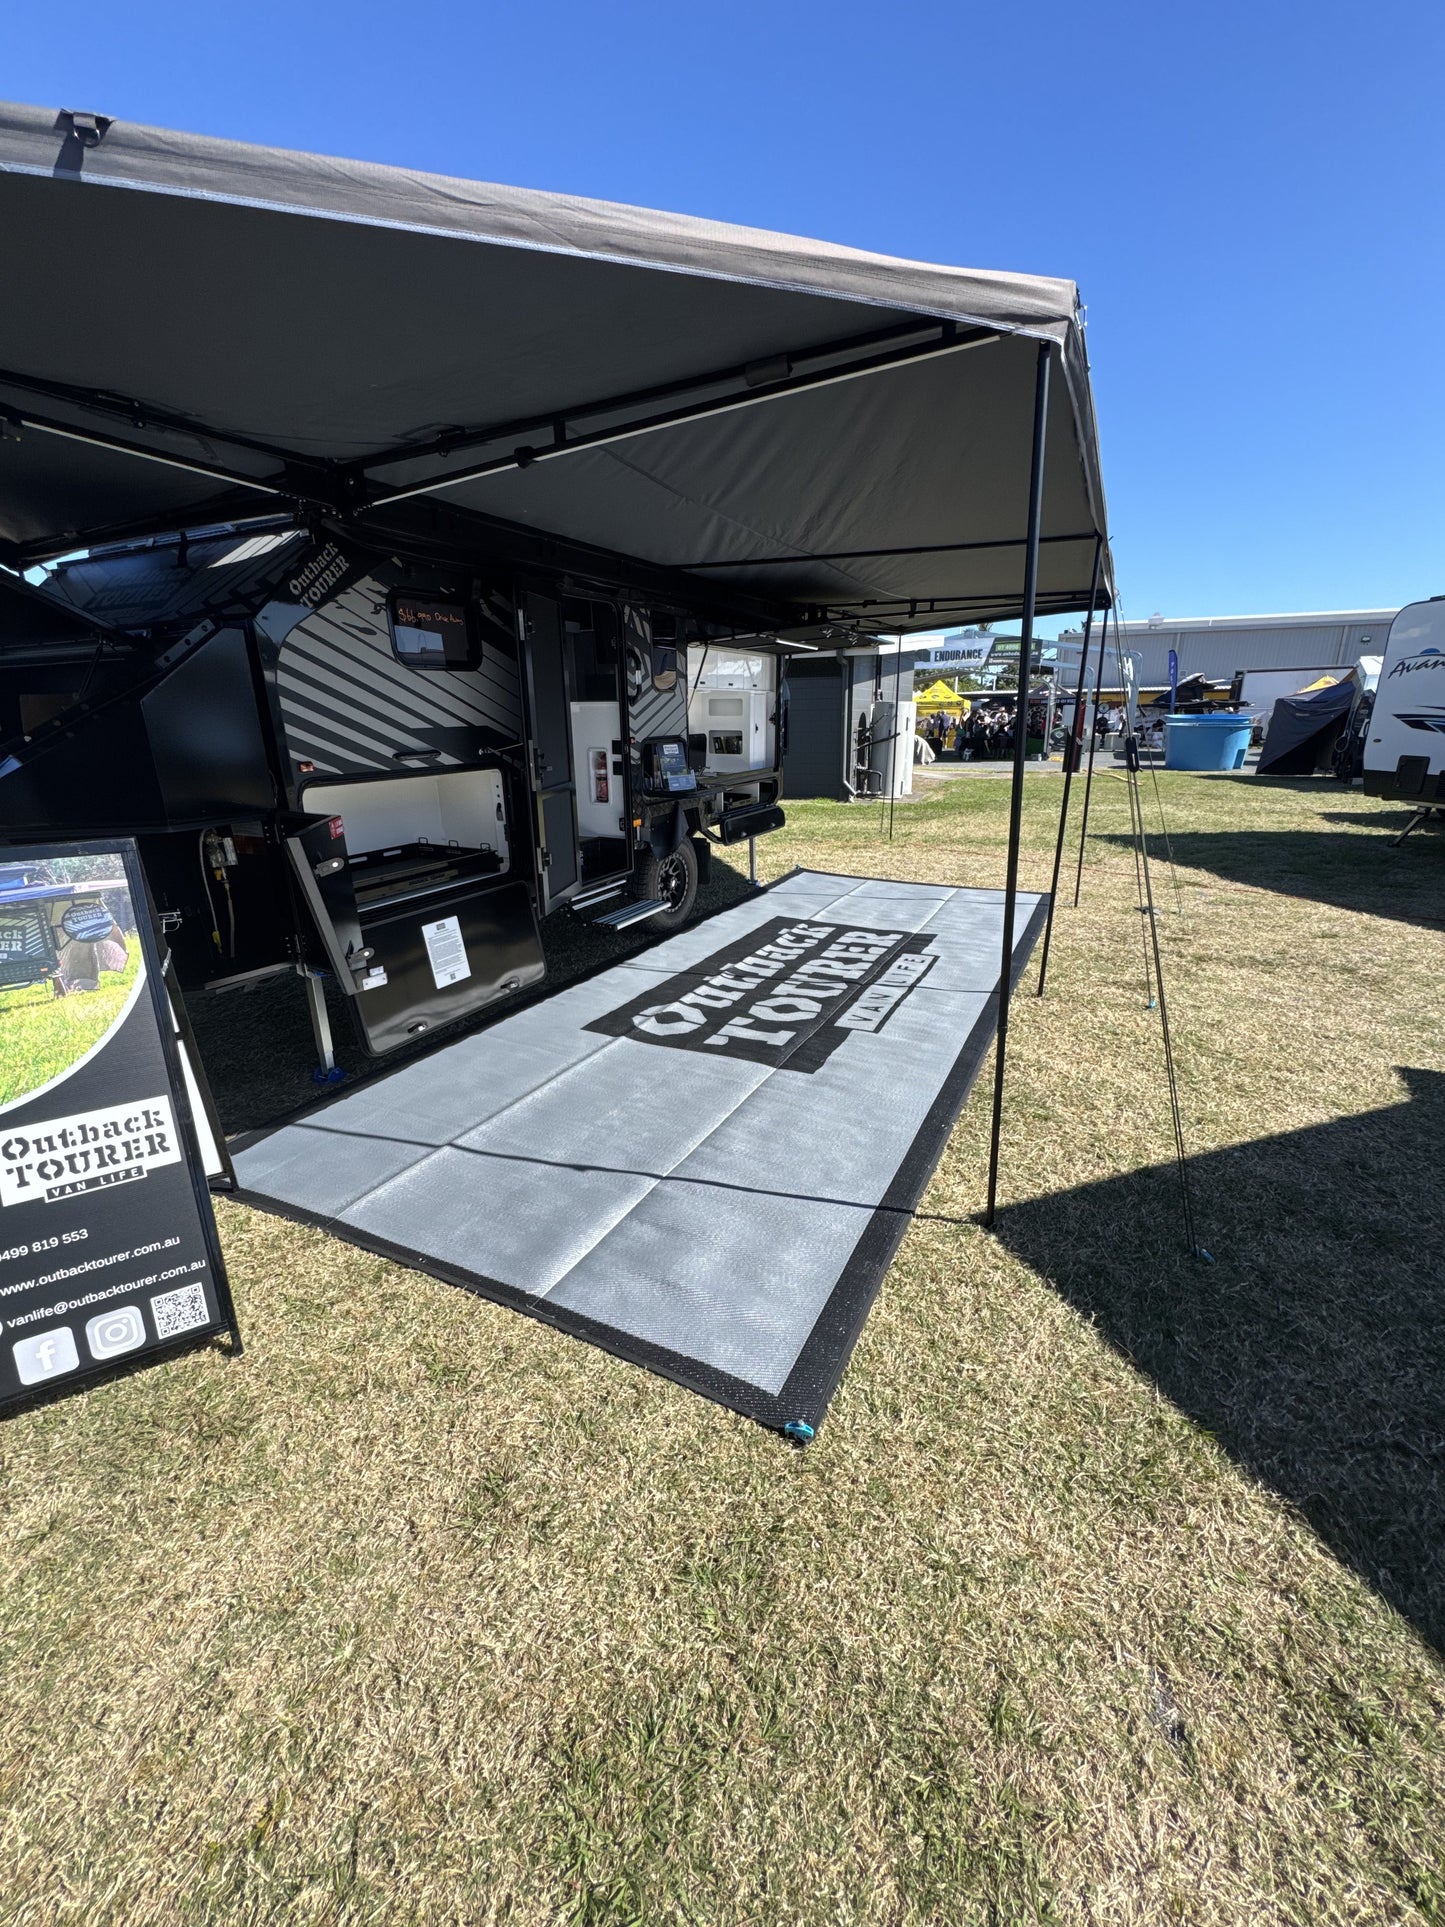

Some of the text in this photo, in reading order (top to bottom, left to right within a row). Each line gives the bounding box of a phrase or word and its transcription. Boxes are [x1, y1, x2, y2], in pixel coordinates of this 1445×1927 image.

[289, 542, 339, 595] Outback
[300, 555, 350, 608] TOURER
[934, 649, 983, 662] ENDURANCE
[632, 923, 837, 1036] Outback
[703, 931, 903, 1047] TOURER
[847, 992, 892, 1022] VAN
[1, 1109, 165, 1161] Outback
[6, 1132, 171, 1189] TOURER
[51, 1167, 140, 1197] VAN LIFE
[0, 1235, 181, 1298] www.outbacktourer.com.au
[32, 1236, 59, 1253] 819
[62, 1228, 89, 1244] 553
[6, 1258, 206, 1320] vanlife@outbacktourer.com.au
